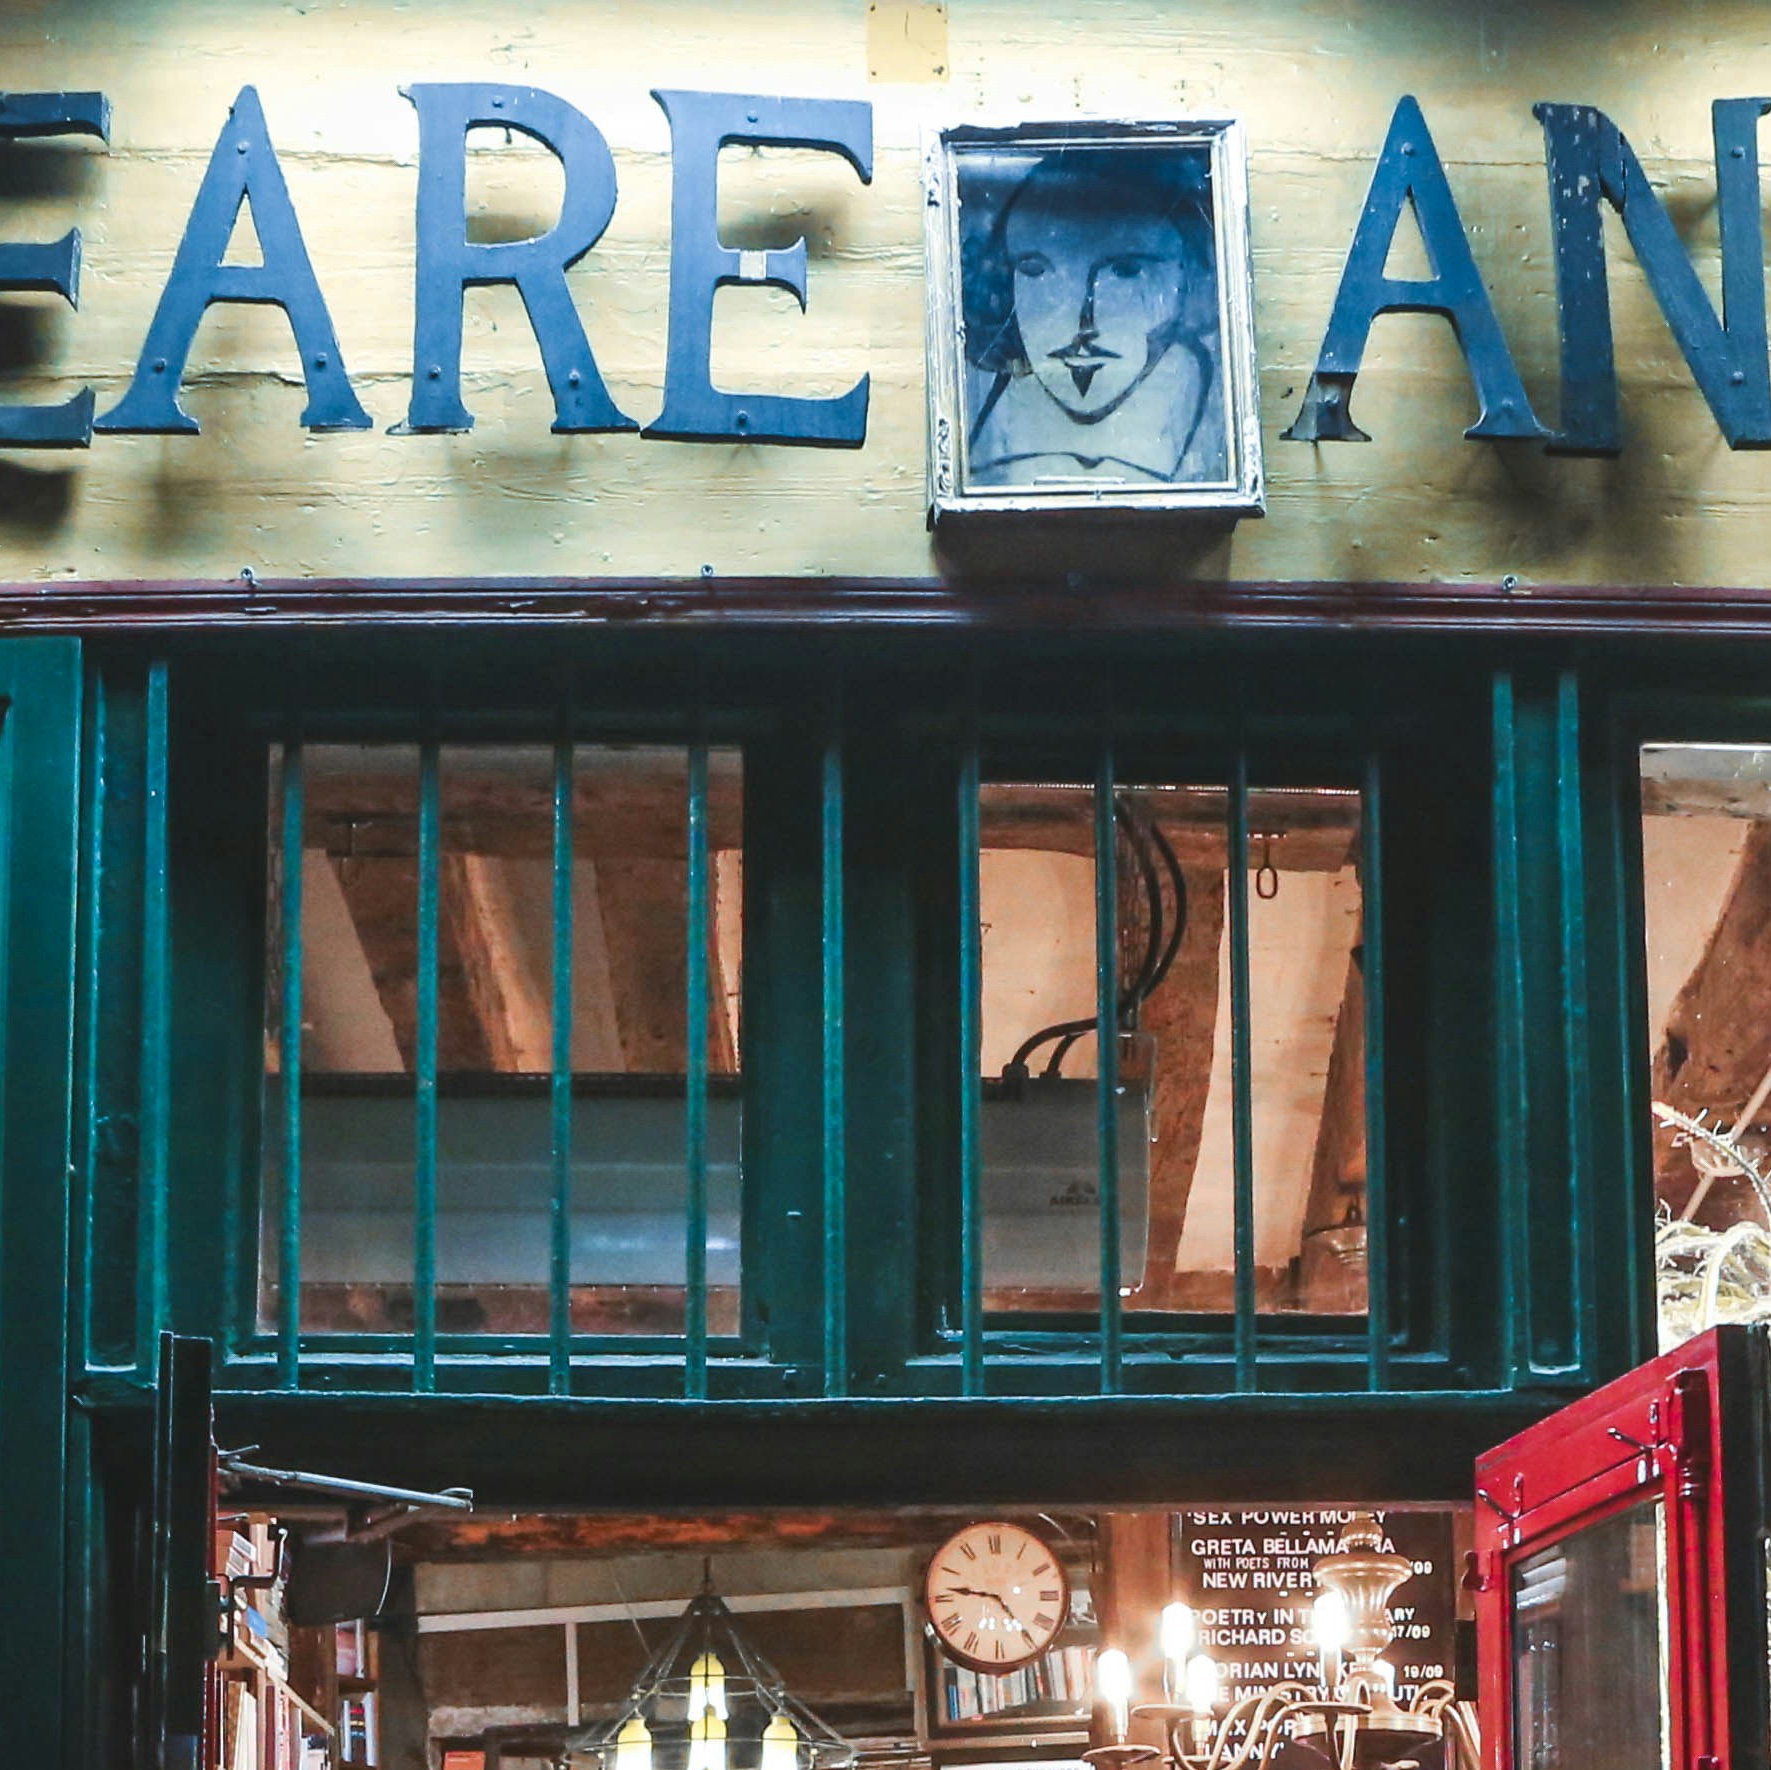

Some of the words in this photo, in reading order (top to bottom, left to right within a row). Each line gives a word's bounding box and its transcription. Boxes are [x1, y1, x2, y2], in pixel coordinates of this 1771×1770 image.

[1191, 1539, 1256, 1555] GRETA
[1203, 1558, 1232, 1570] WITH
[1235, 1557, 1270, 1569] POETS
[1277, 1557, 1309, 1569] FROM
[1202, 1573, 1246, 1589] NEW
[1273, 1609, 1294, 1625] IN
[1197, 1628, 1286, 1645] RICHARD
[1403, 1665, 1444, 1679] 19/09
